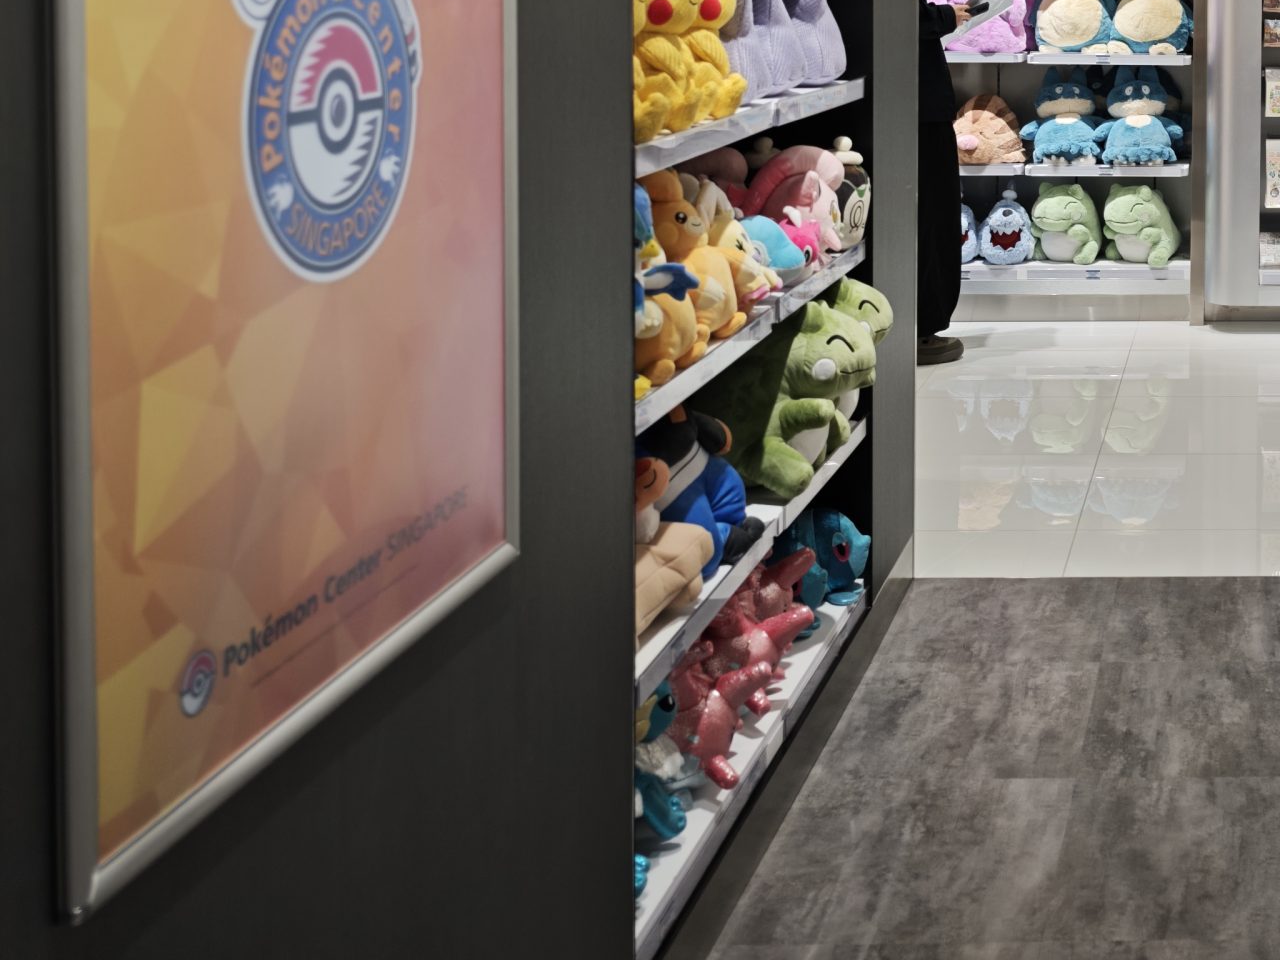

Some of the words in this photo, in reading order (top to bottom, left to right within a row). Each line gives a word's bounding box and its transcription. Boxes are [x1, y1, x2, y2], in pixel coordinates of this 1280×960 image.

[286, 184, 388, 256] SINGAPORE
[222, 593, 319, 677] Pokémon
[323, 547, 383, 604] Center
[385, 486, 469, 561] SINGAPORE
